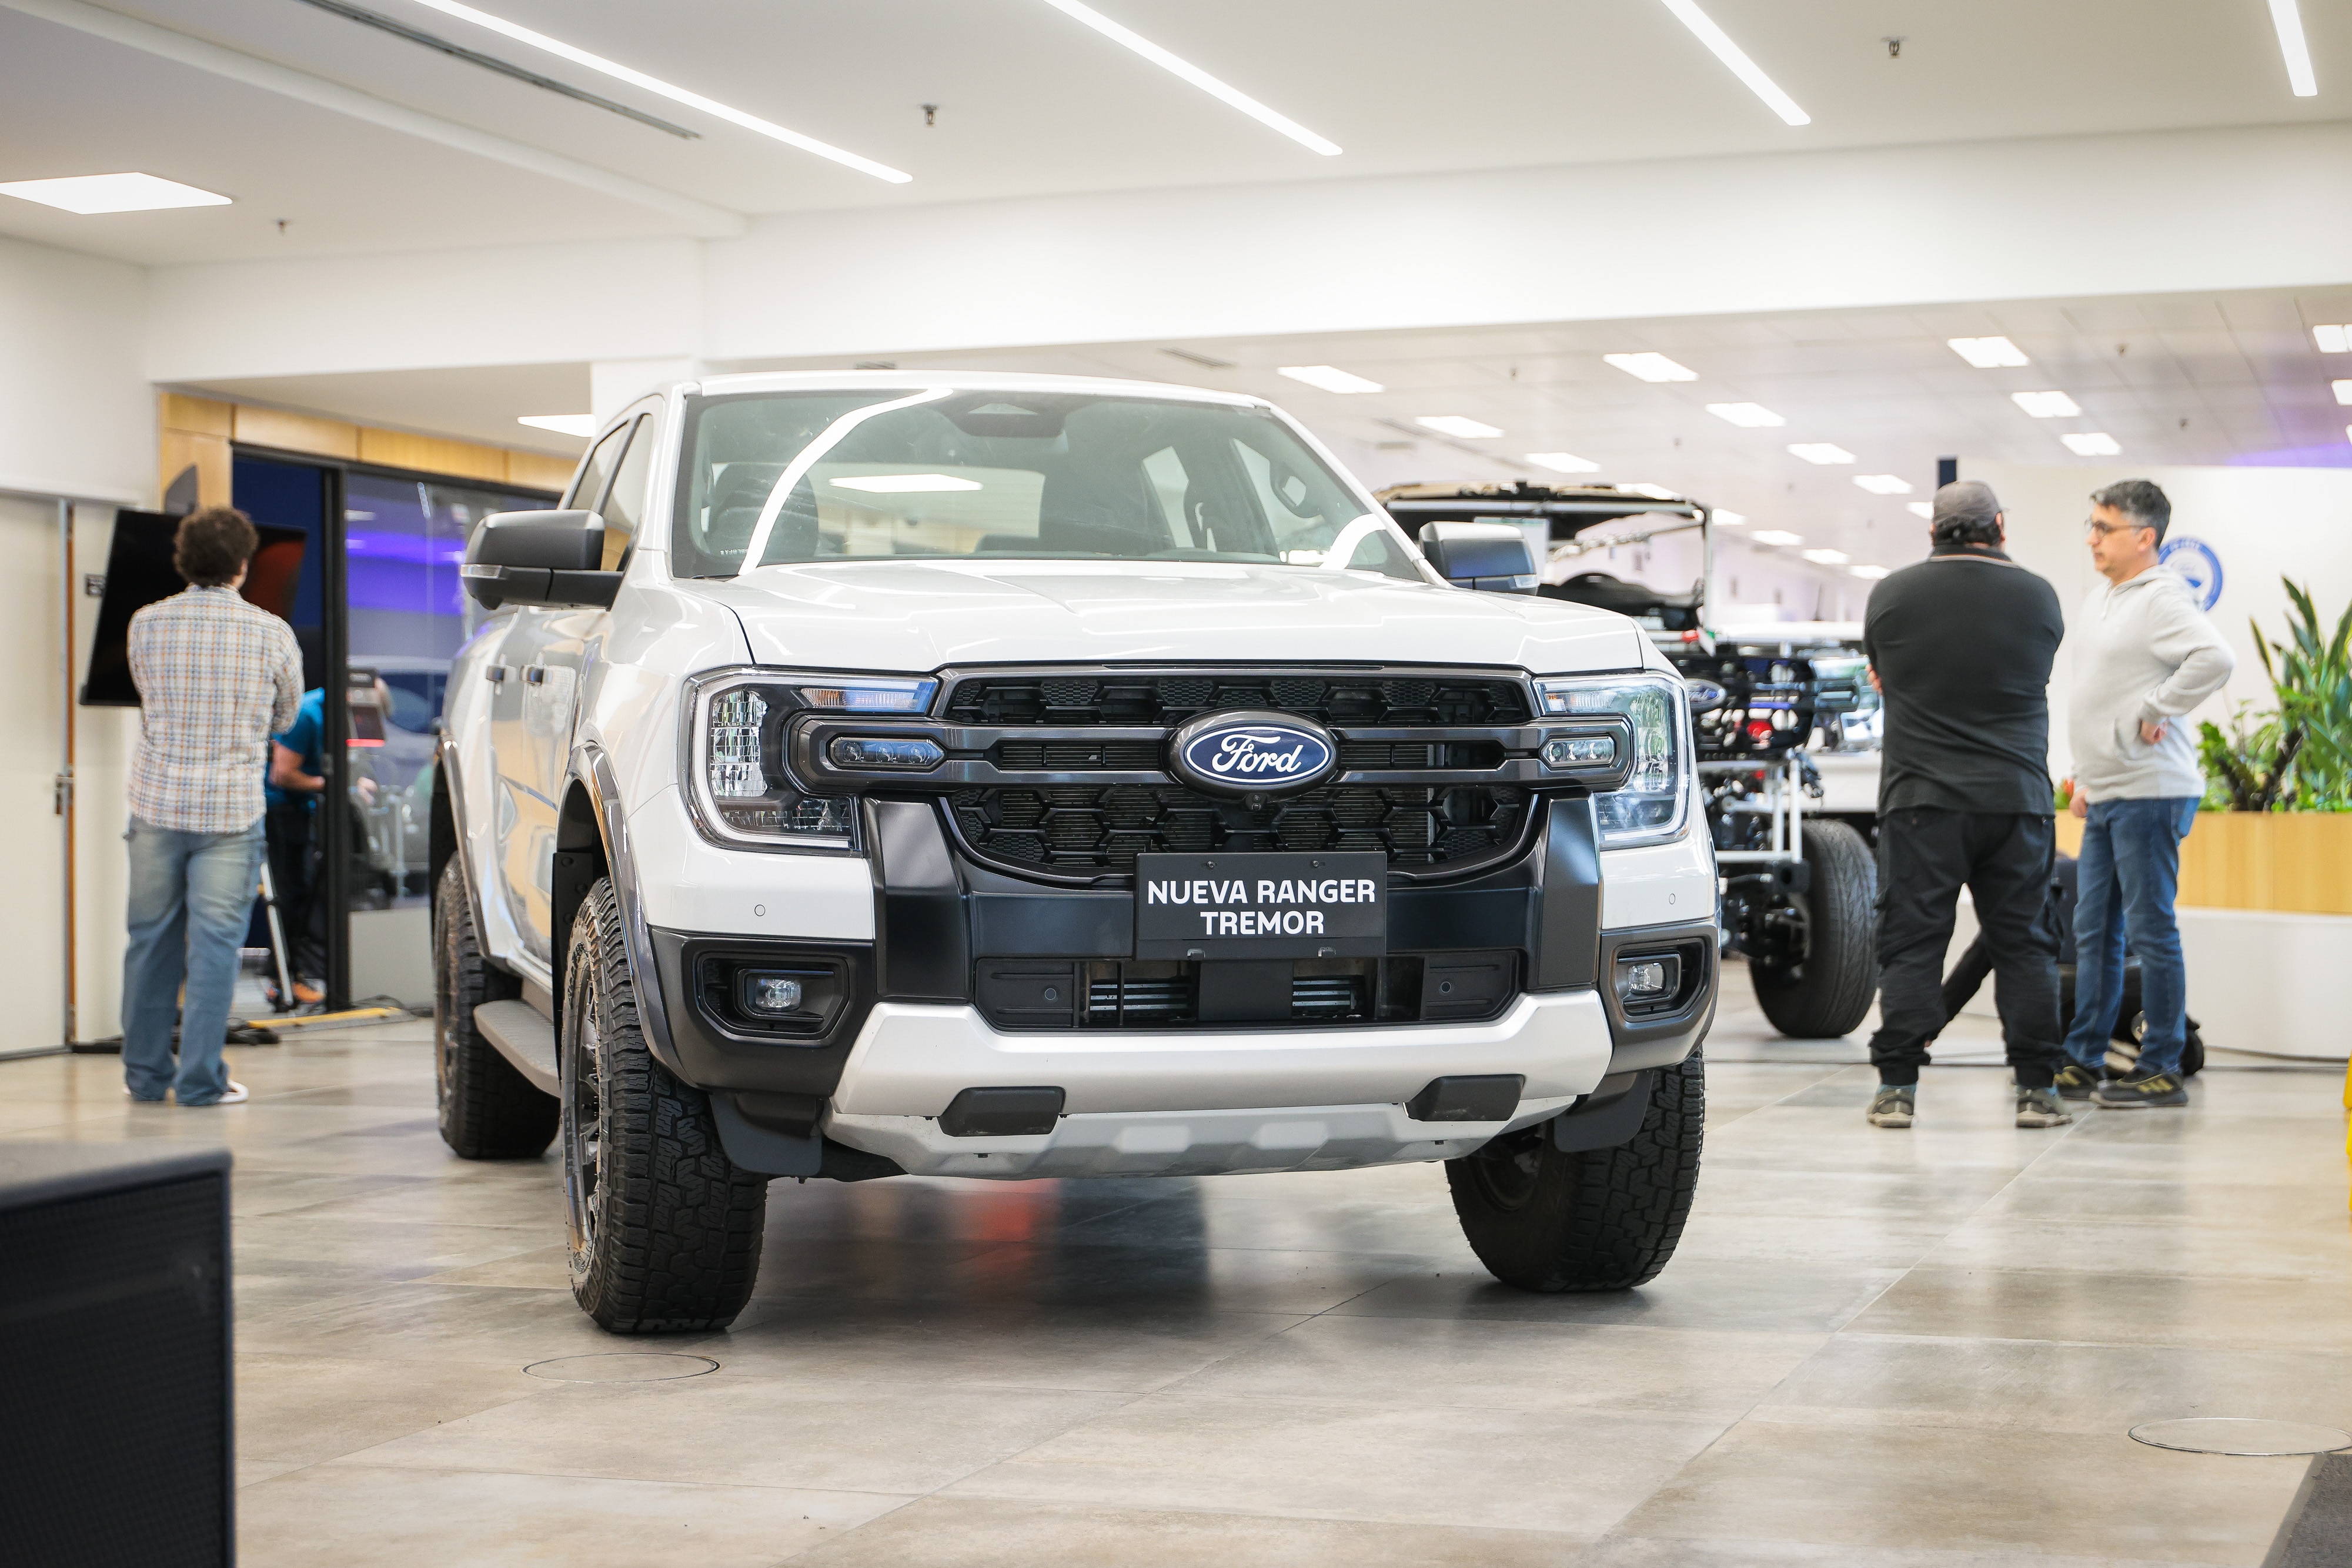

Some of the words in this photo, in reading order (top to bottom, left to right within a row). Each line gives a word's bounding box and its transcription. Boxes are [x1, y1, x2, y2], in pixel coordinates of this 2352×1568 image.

[1212, 734, 1304, 773] Ford
[1148, 880, 1248, 904] NUEVA
[1257, 879, 1375, 904] RANGER
[1200, 911, 1324, 935] TREMOR
